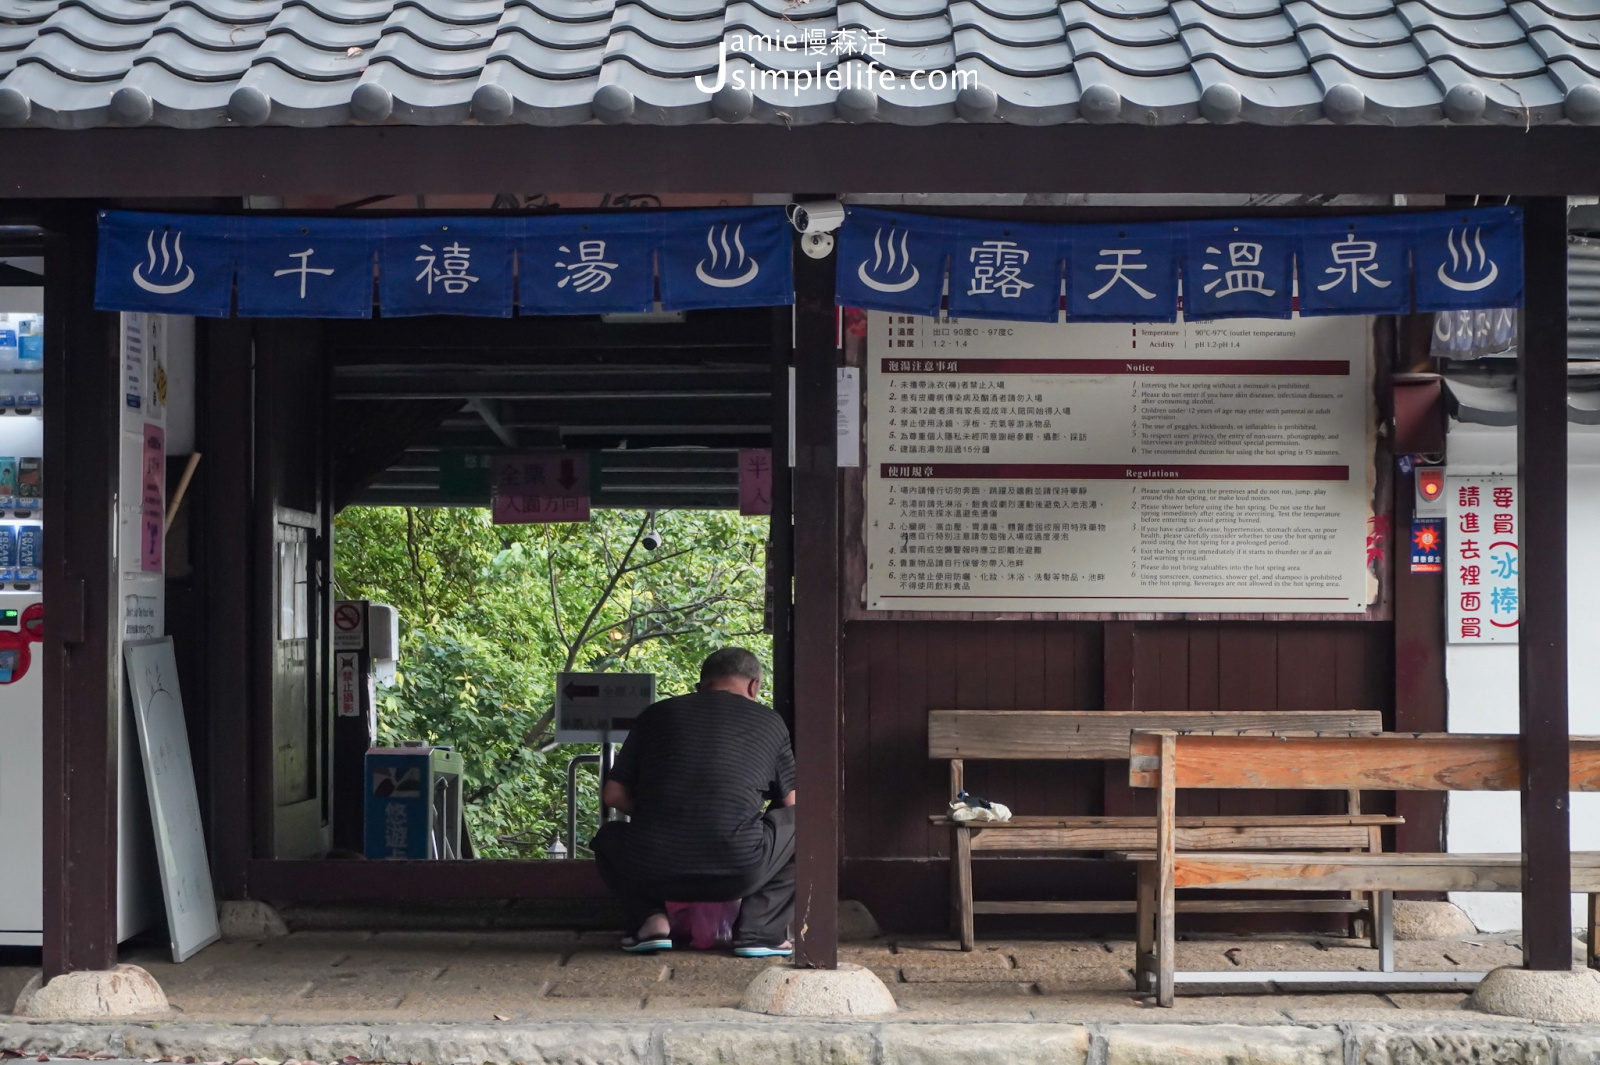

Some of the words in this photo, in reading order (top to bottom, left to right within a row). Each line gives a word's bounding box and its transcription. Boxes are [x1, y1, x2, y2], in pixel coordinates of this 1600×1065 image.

[274, 241, 618, 299] 千禧湯
[967, 233, 1392, 300] 露天溫泉
[889, 361, 957, 372] 泡湯注意事項
[1126, 364, 1155, 372] Notice
[888, 466, 934, 477] 使用規章
[1126, 470, 1179, 478] Regulations
[1459, 486, 1480, 638] 請進去裡面買
[1489, 487, 1519, 628] 要買(冰棒)
